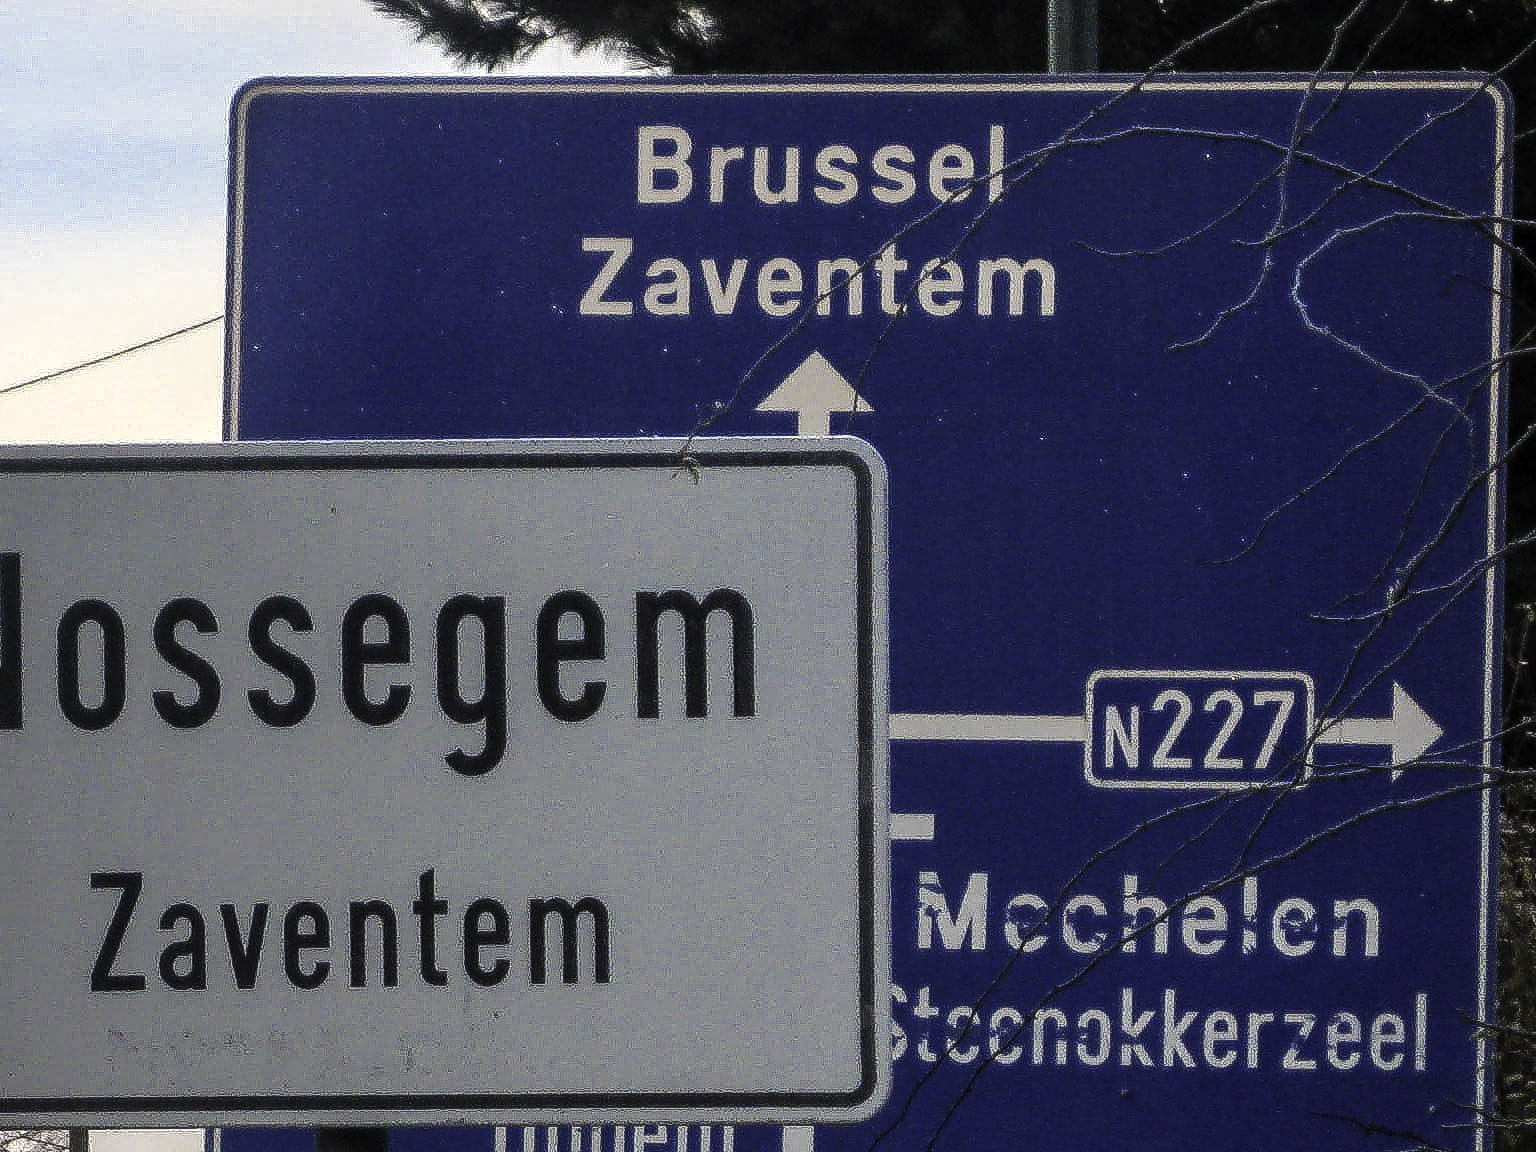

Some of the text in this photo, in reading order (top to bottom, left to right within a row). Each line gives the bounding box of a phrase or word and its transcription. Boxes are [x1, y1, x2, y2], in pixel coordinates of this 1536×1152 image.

[636, 124, 1007, 204] Brussel
[578, 236, 1057, 317] Zaventem
[1104, 690, 1295, 770] N227
[89, 868, 612, 993] Zaventem
[917, 871, 1380, 957] Mechelen
